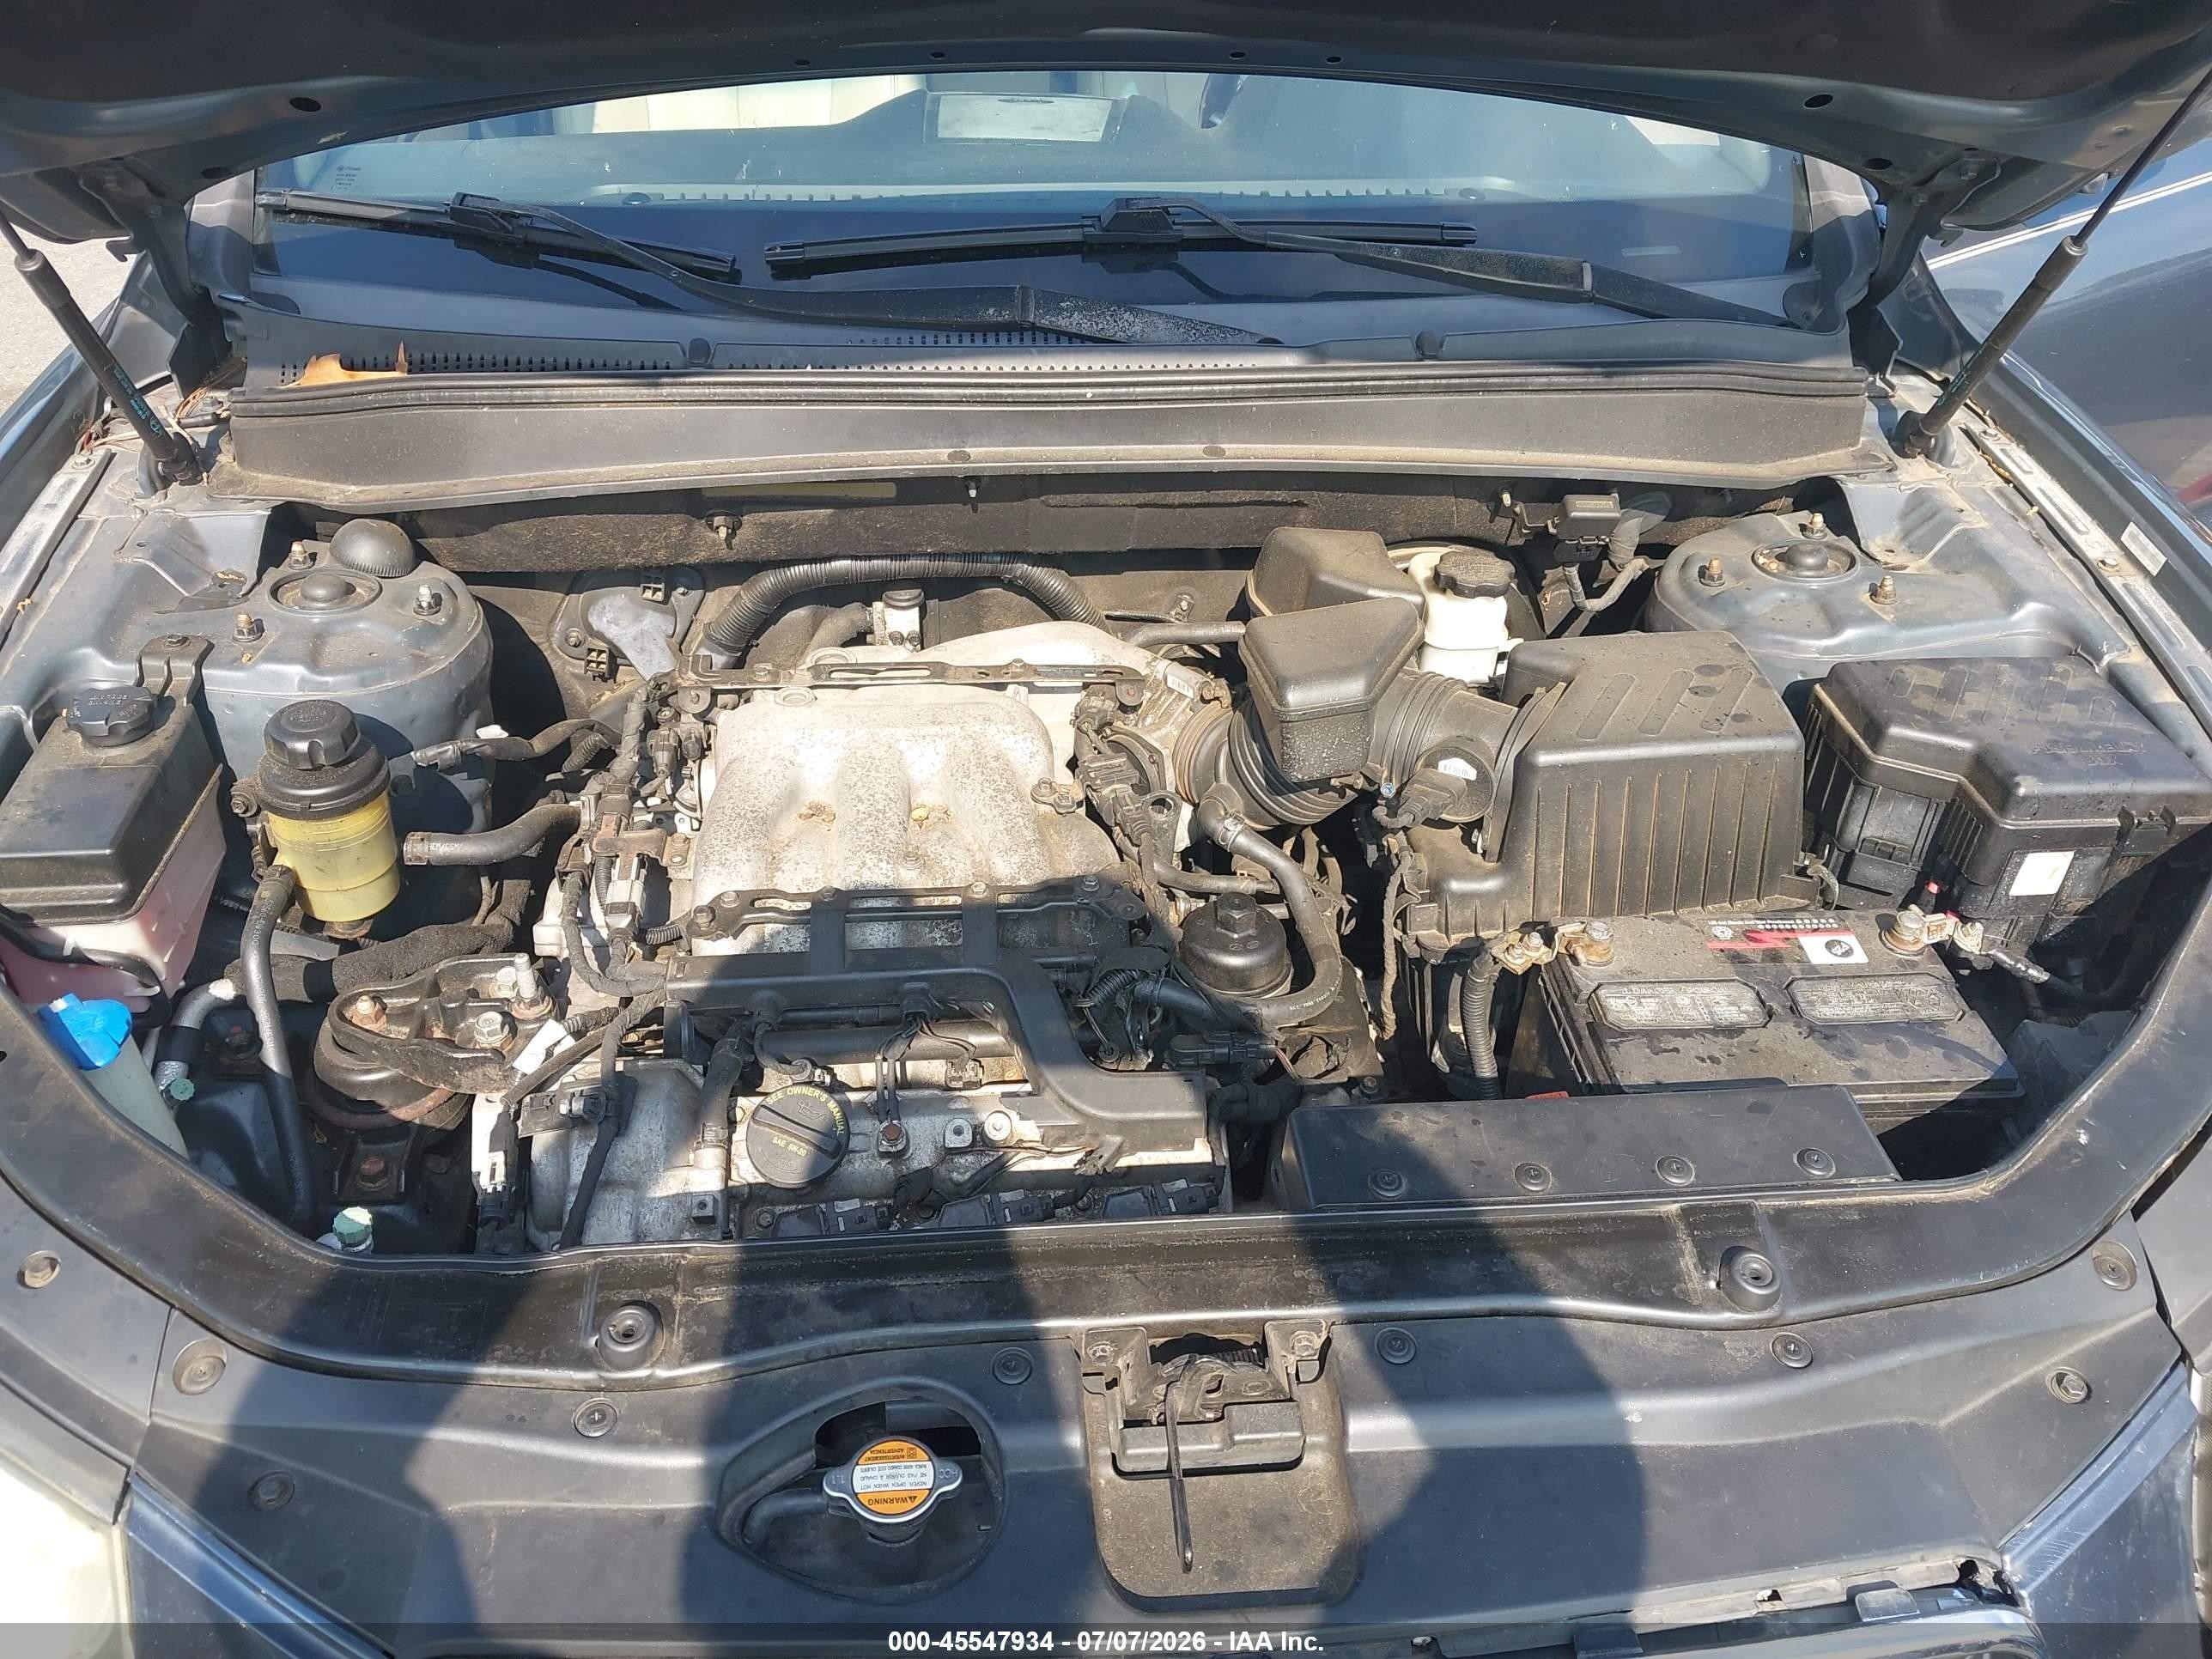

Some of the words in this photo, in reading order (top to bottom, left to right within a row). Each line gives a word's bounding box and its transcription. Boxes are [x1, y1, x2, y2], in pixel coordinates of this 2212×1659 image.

[766, 1092, 784, 1105] SEE
[787, 1087, 828, 1101] OWNER'S
[826, 1102, 845, 1135] MANUAL
[773, 1137, 786, 1148] SAE
[787, 1144, 807, 1157] 5W-20
[867, 1497, 908, 1505] WARNING
